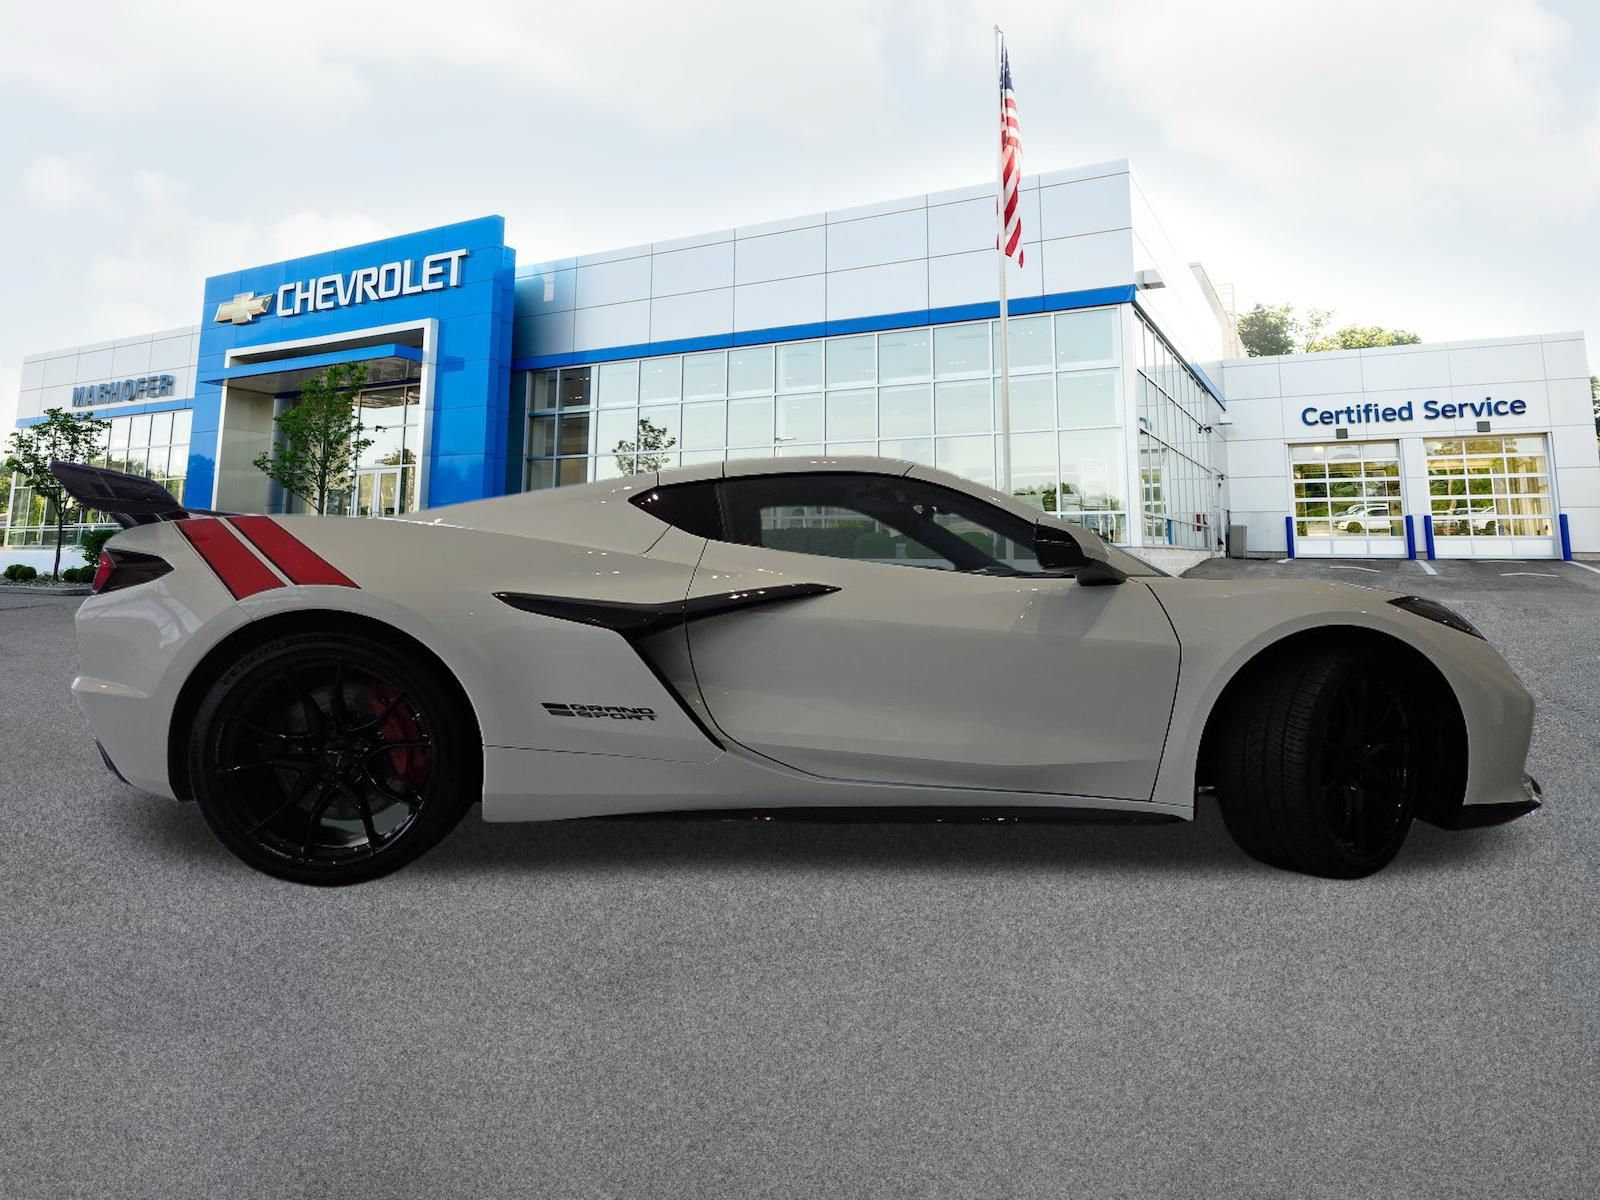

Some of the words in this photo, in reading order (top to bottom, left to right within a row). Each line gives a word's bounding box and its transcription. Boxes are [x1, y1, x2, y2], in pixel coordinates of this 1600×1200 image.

[276, 248, 469, 317] CHEVROLET
[72, 375, 175, 407] MARHOFER
[1301, 401, 1413, 426] Certified
[1423, 397, 1527, 420] Service
[569, 704, 655, 714] GRAND
[575, 711, 657, 721] SPORT
